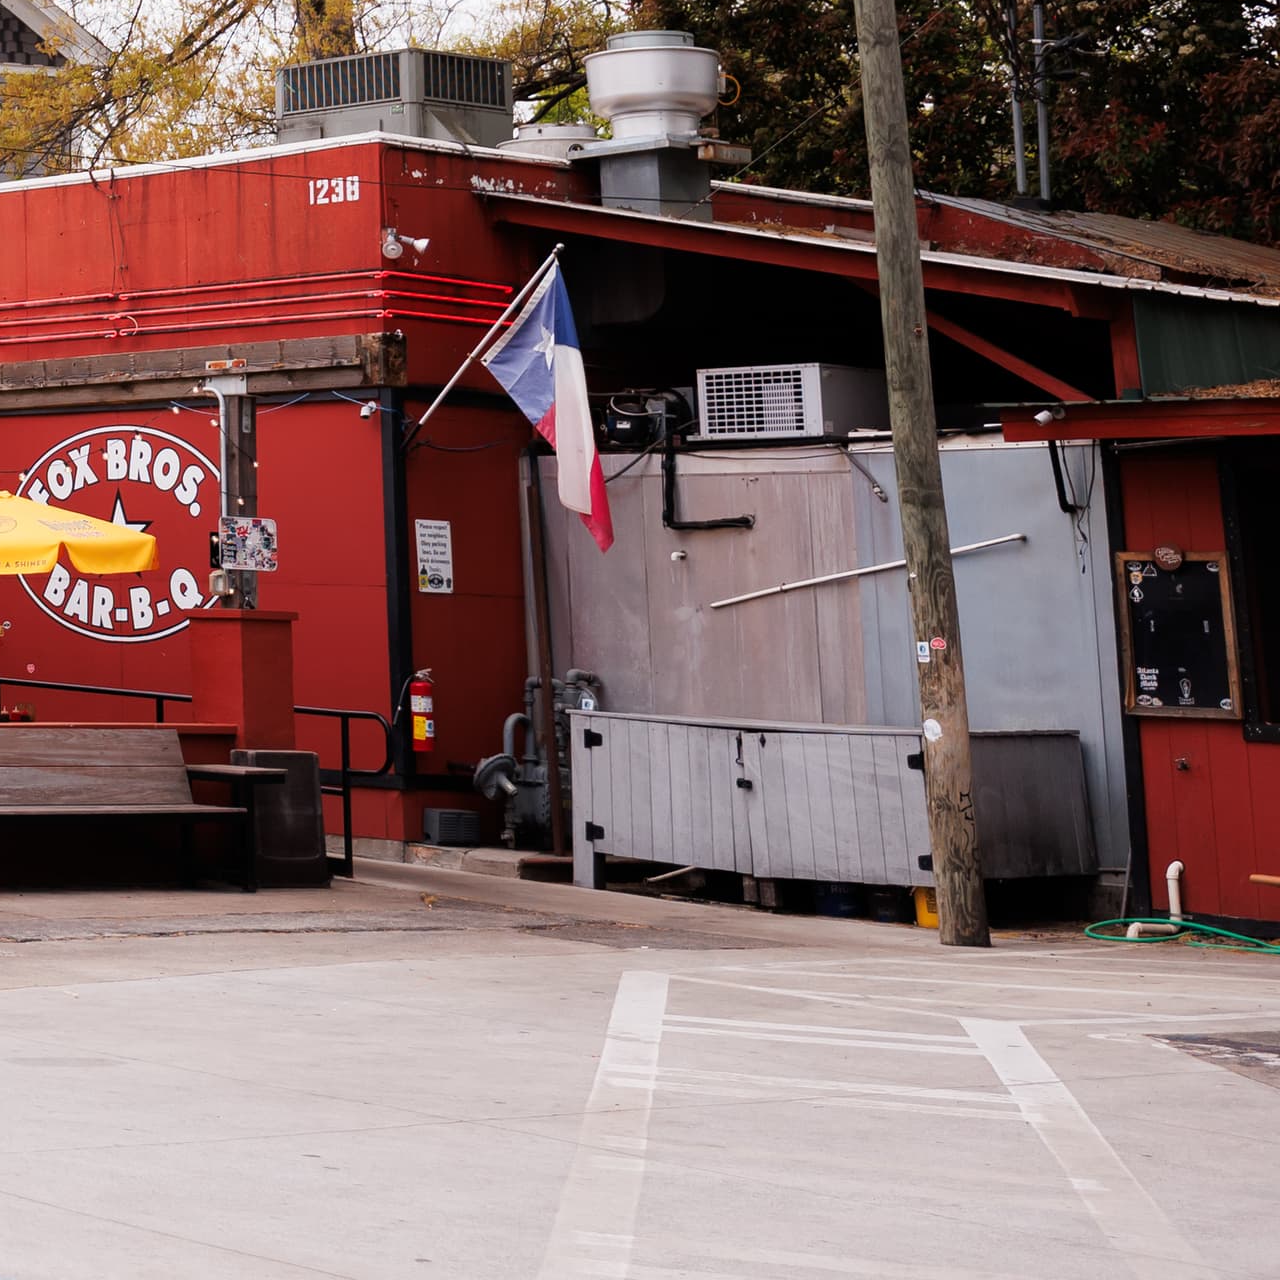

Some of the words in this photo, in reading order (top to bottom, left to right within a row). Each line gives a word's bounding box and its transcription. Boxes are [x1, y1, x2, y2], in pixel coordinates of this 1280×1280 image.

[308, 175, 360, 206] 1238
[27, 443, 99, 506] FOX
[106, 438, 205, 517] BROS.
[14, 560, 47, 568] SHINER
[42, 563, 204, 631] BAR-B-Q
